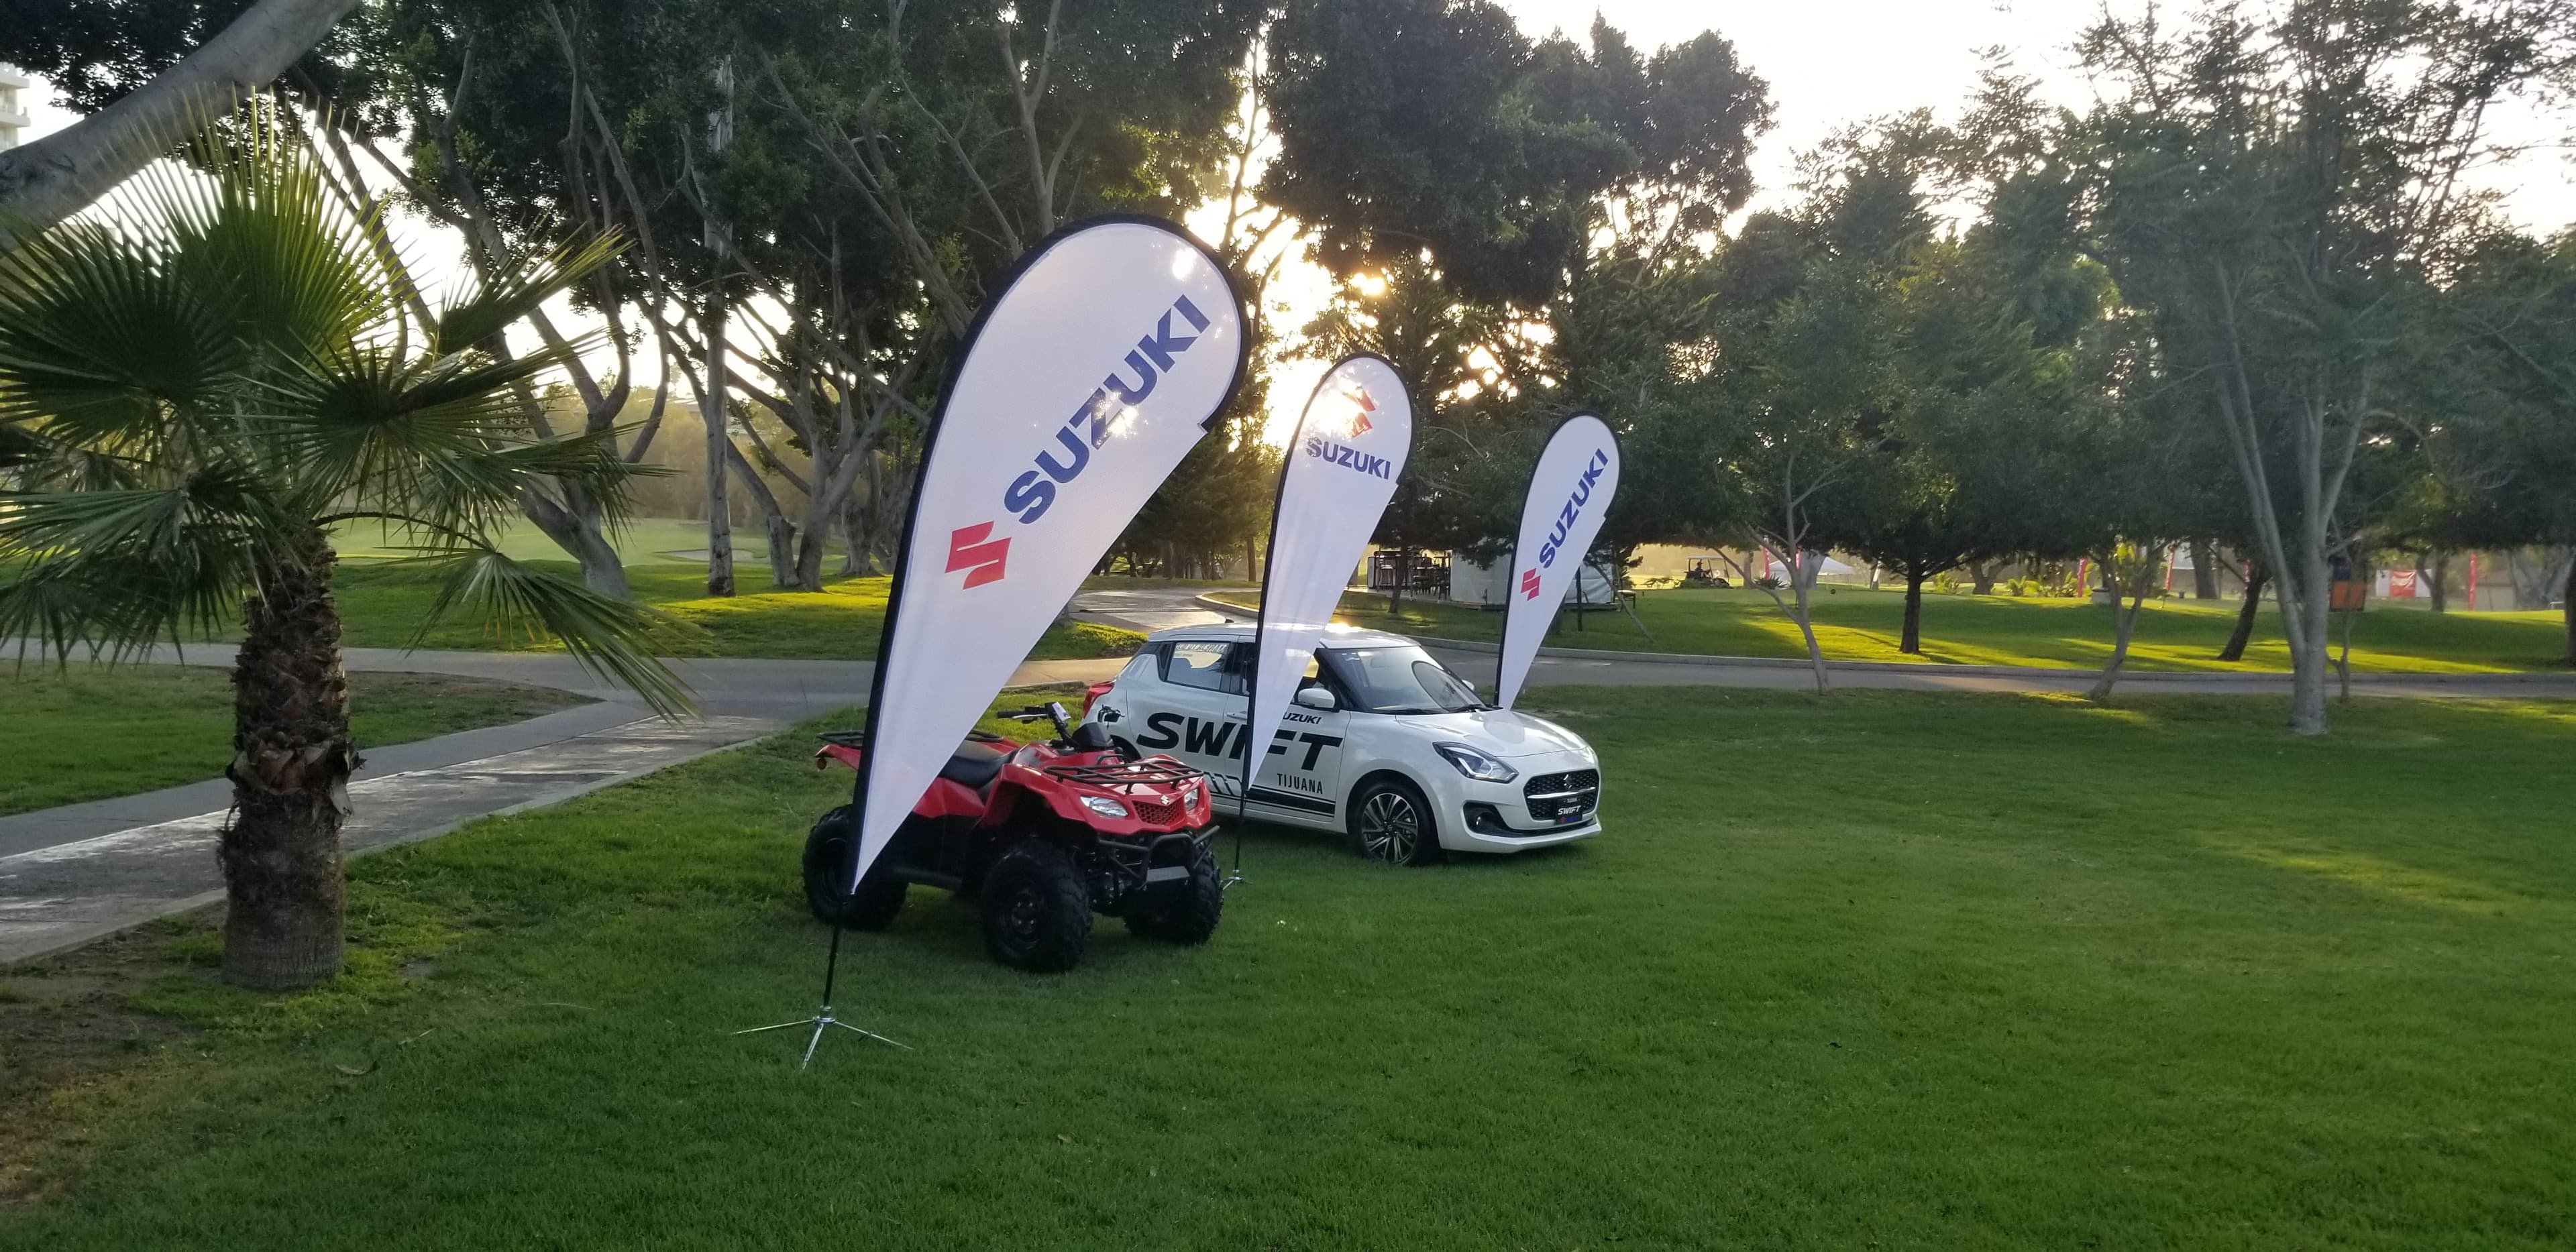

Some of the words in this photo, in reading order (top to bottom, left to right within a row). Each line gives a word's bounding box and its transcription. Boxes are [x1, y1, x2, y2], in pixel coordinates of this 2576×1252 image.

[1004, 294, 1211, 524] SUZUKI
[1306, 436, 1391, 479] SUZUKI
[1539, 448, 1609, 569] SUZUKI
[1282, 712, 1322, 724] UZUKI
[1277, 773, 1323, 795] TIJUANA
[1558, 805, 1581, 815] SWIFT
